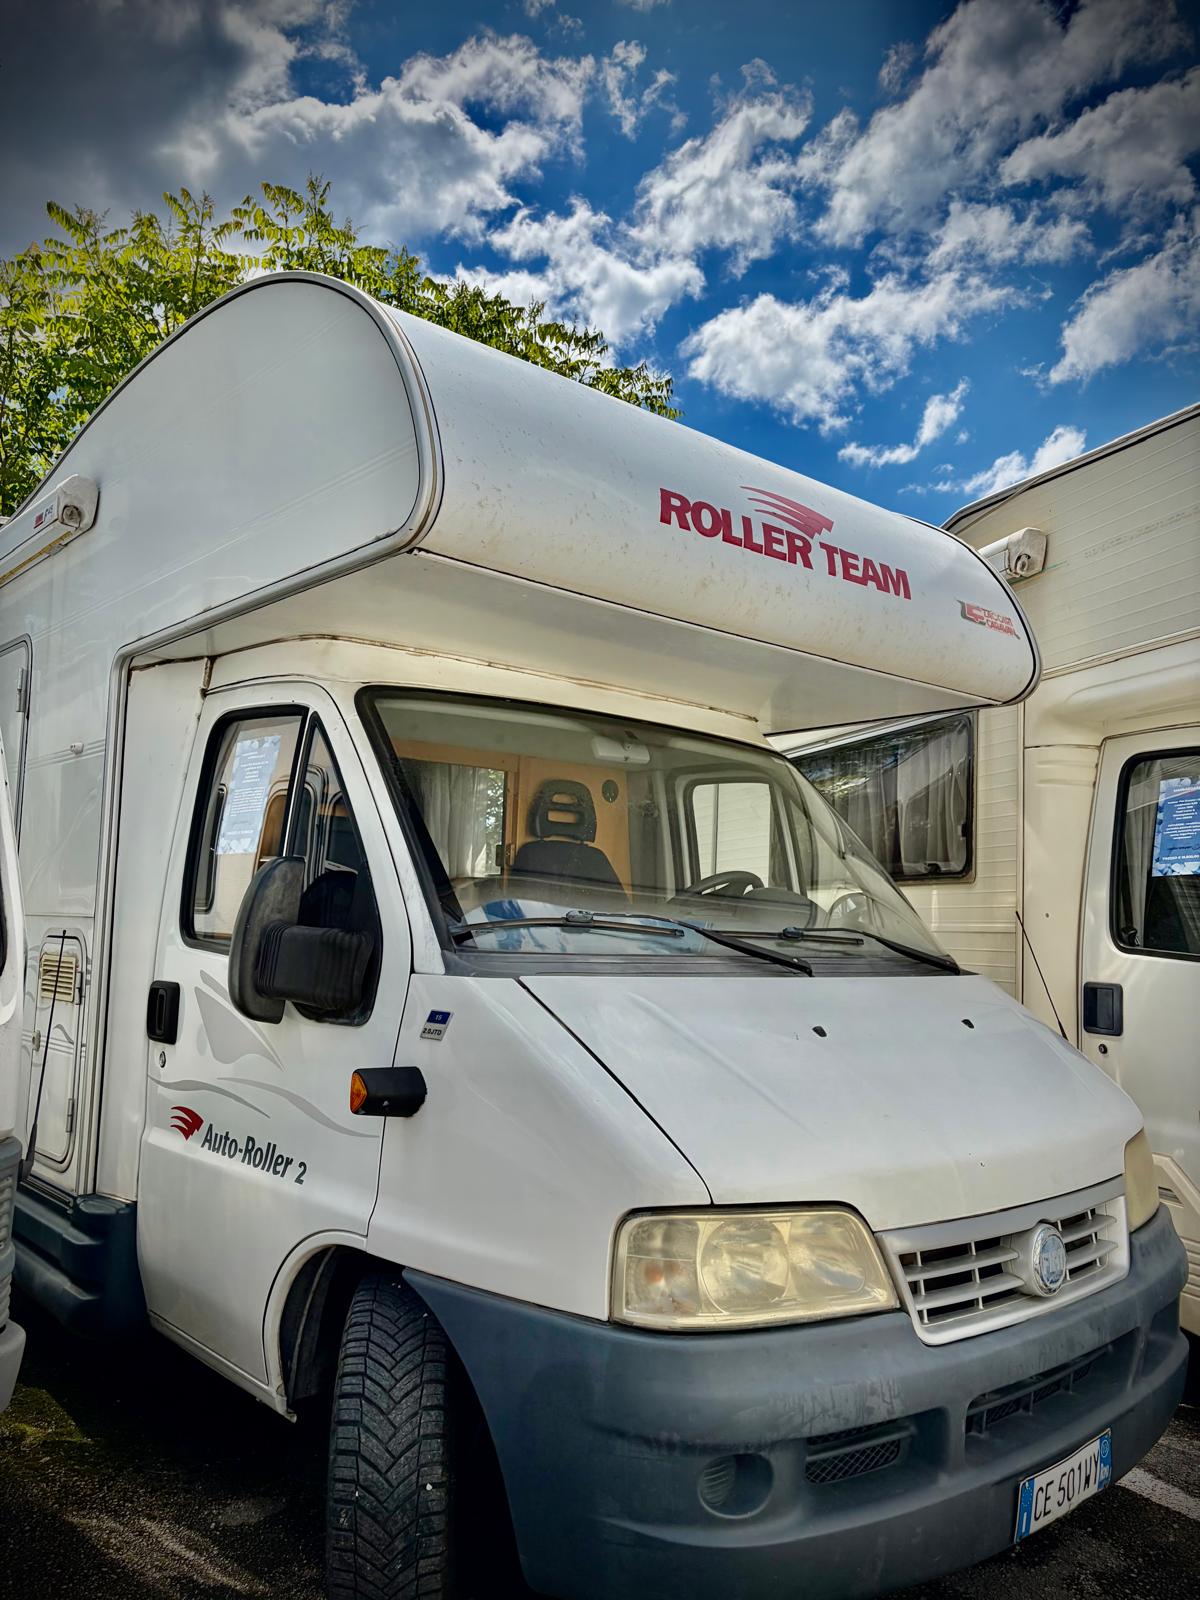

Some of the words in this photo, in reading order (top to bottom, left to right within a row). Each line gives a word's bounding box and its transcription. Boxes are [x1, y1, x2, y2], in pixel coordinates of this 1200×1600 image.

[660, 488, 813, 570] ROLLER
[819, 541, 912, 600] TEAM
[201, 1123, 294, 1178] Auto-Roller
[294, 1161, 307, 1185] 2
